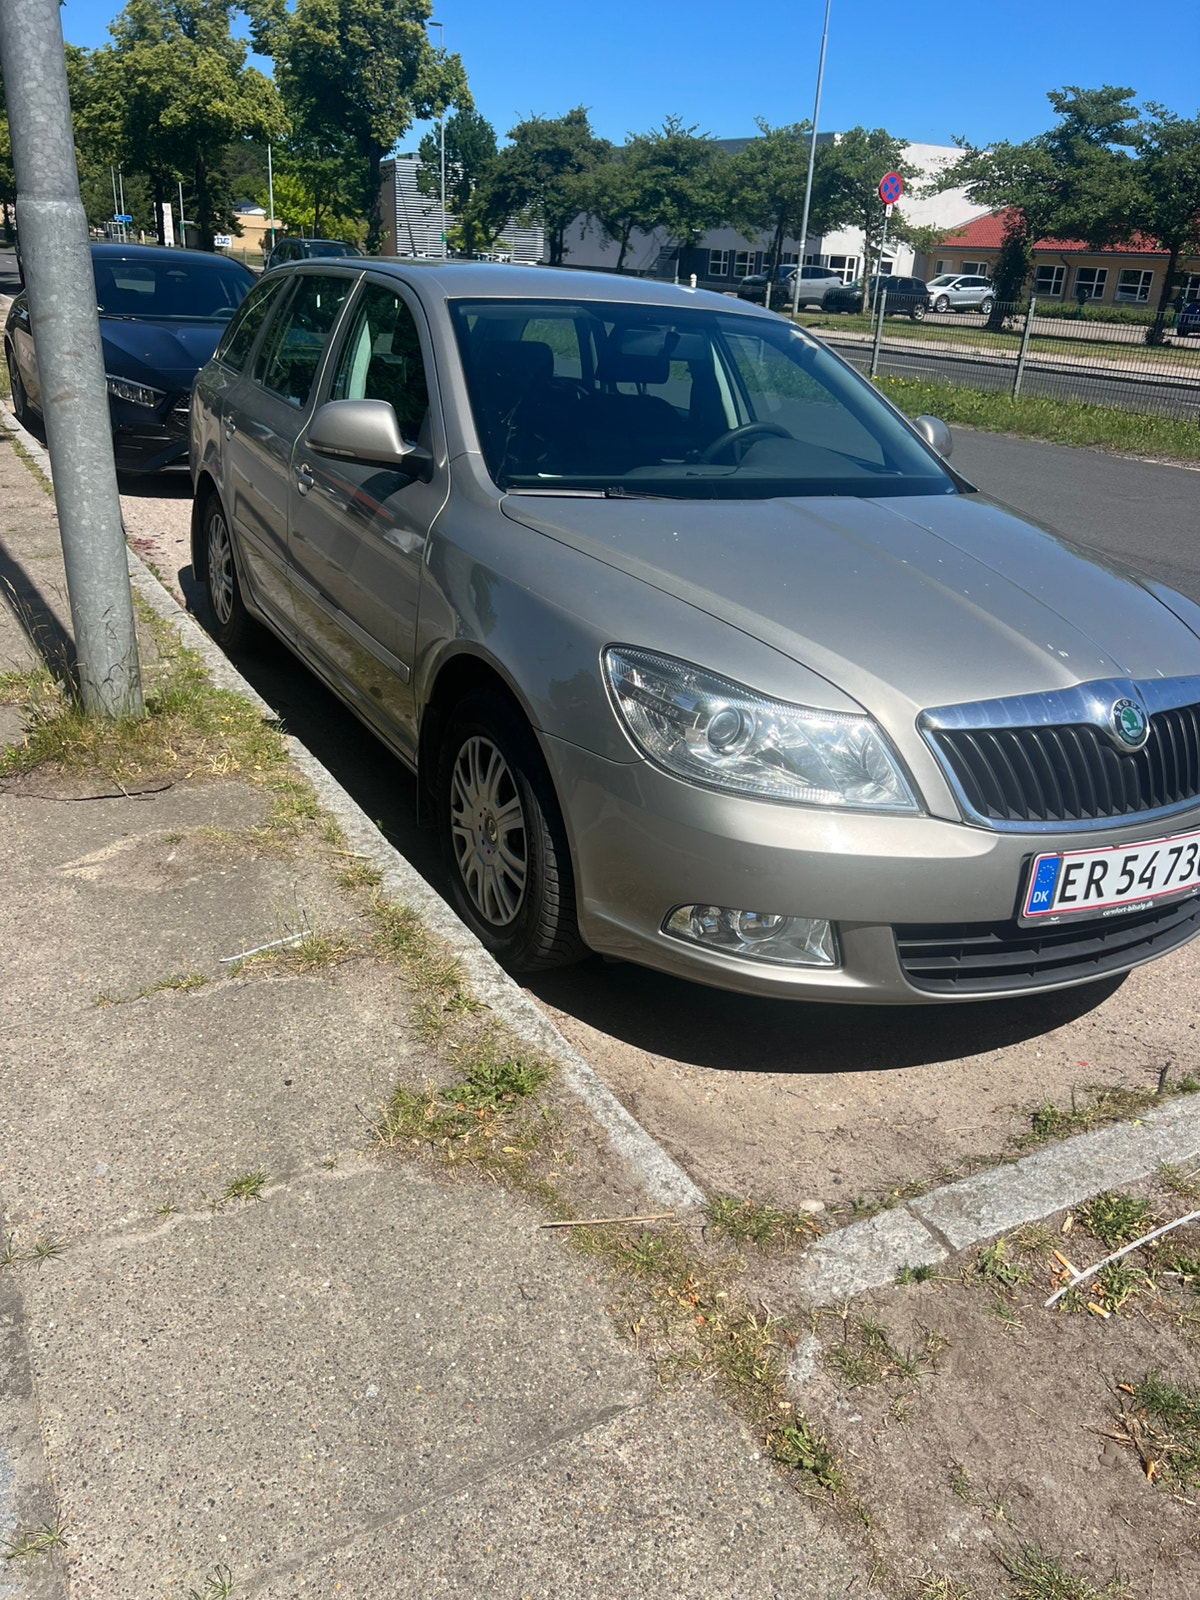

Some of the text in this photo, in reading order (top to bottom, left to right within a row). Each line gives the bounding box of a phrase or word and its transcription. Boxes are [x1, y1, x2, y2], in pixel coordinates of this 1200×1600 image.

[1058, 860, 1109, 903] ER
[1163, 843, 1200, 886] 73
[1032, 890, 1050, 903] DK
